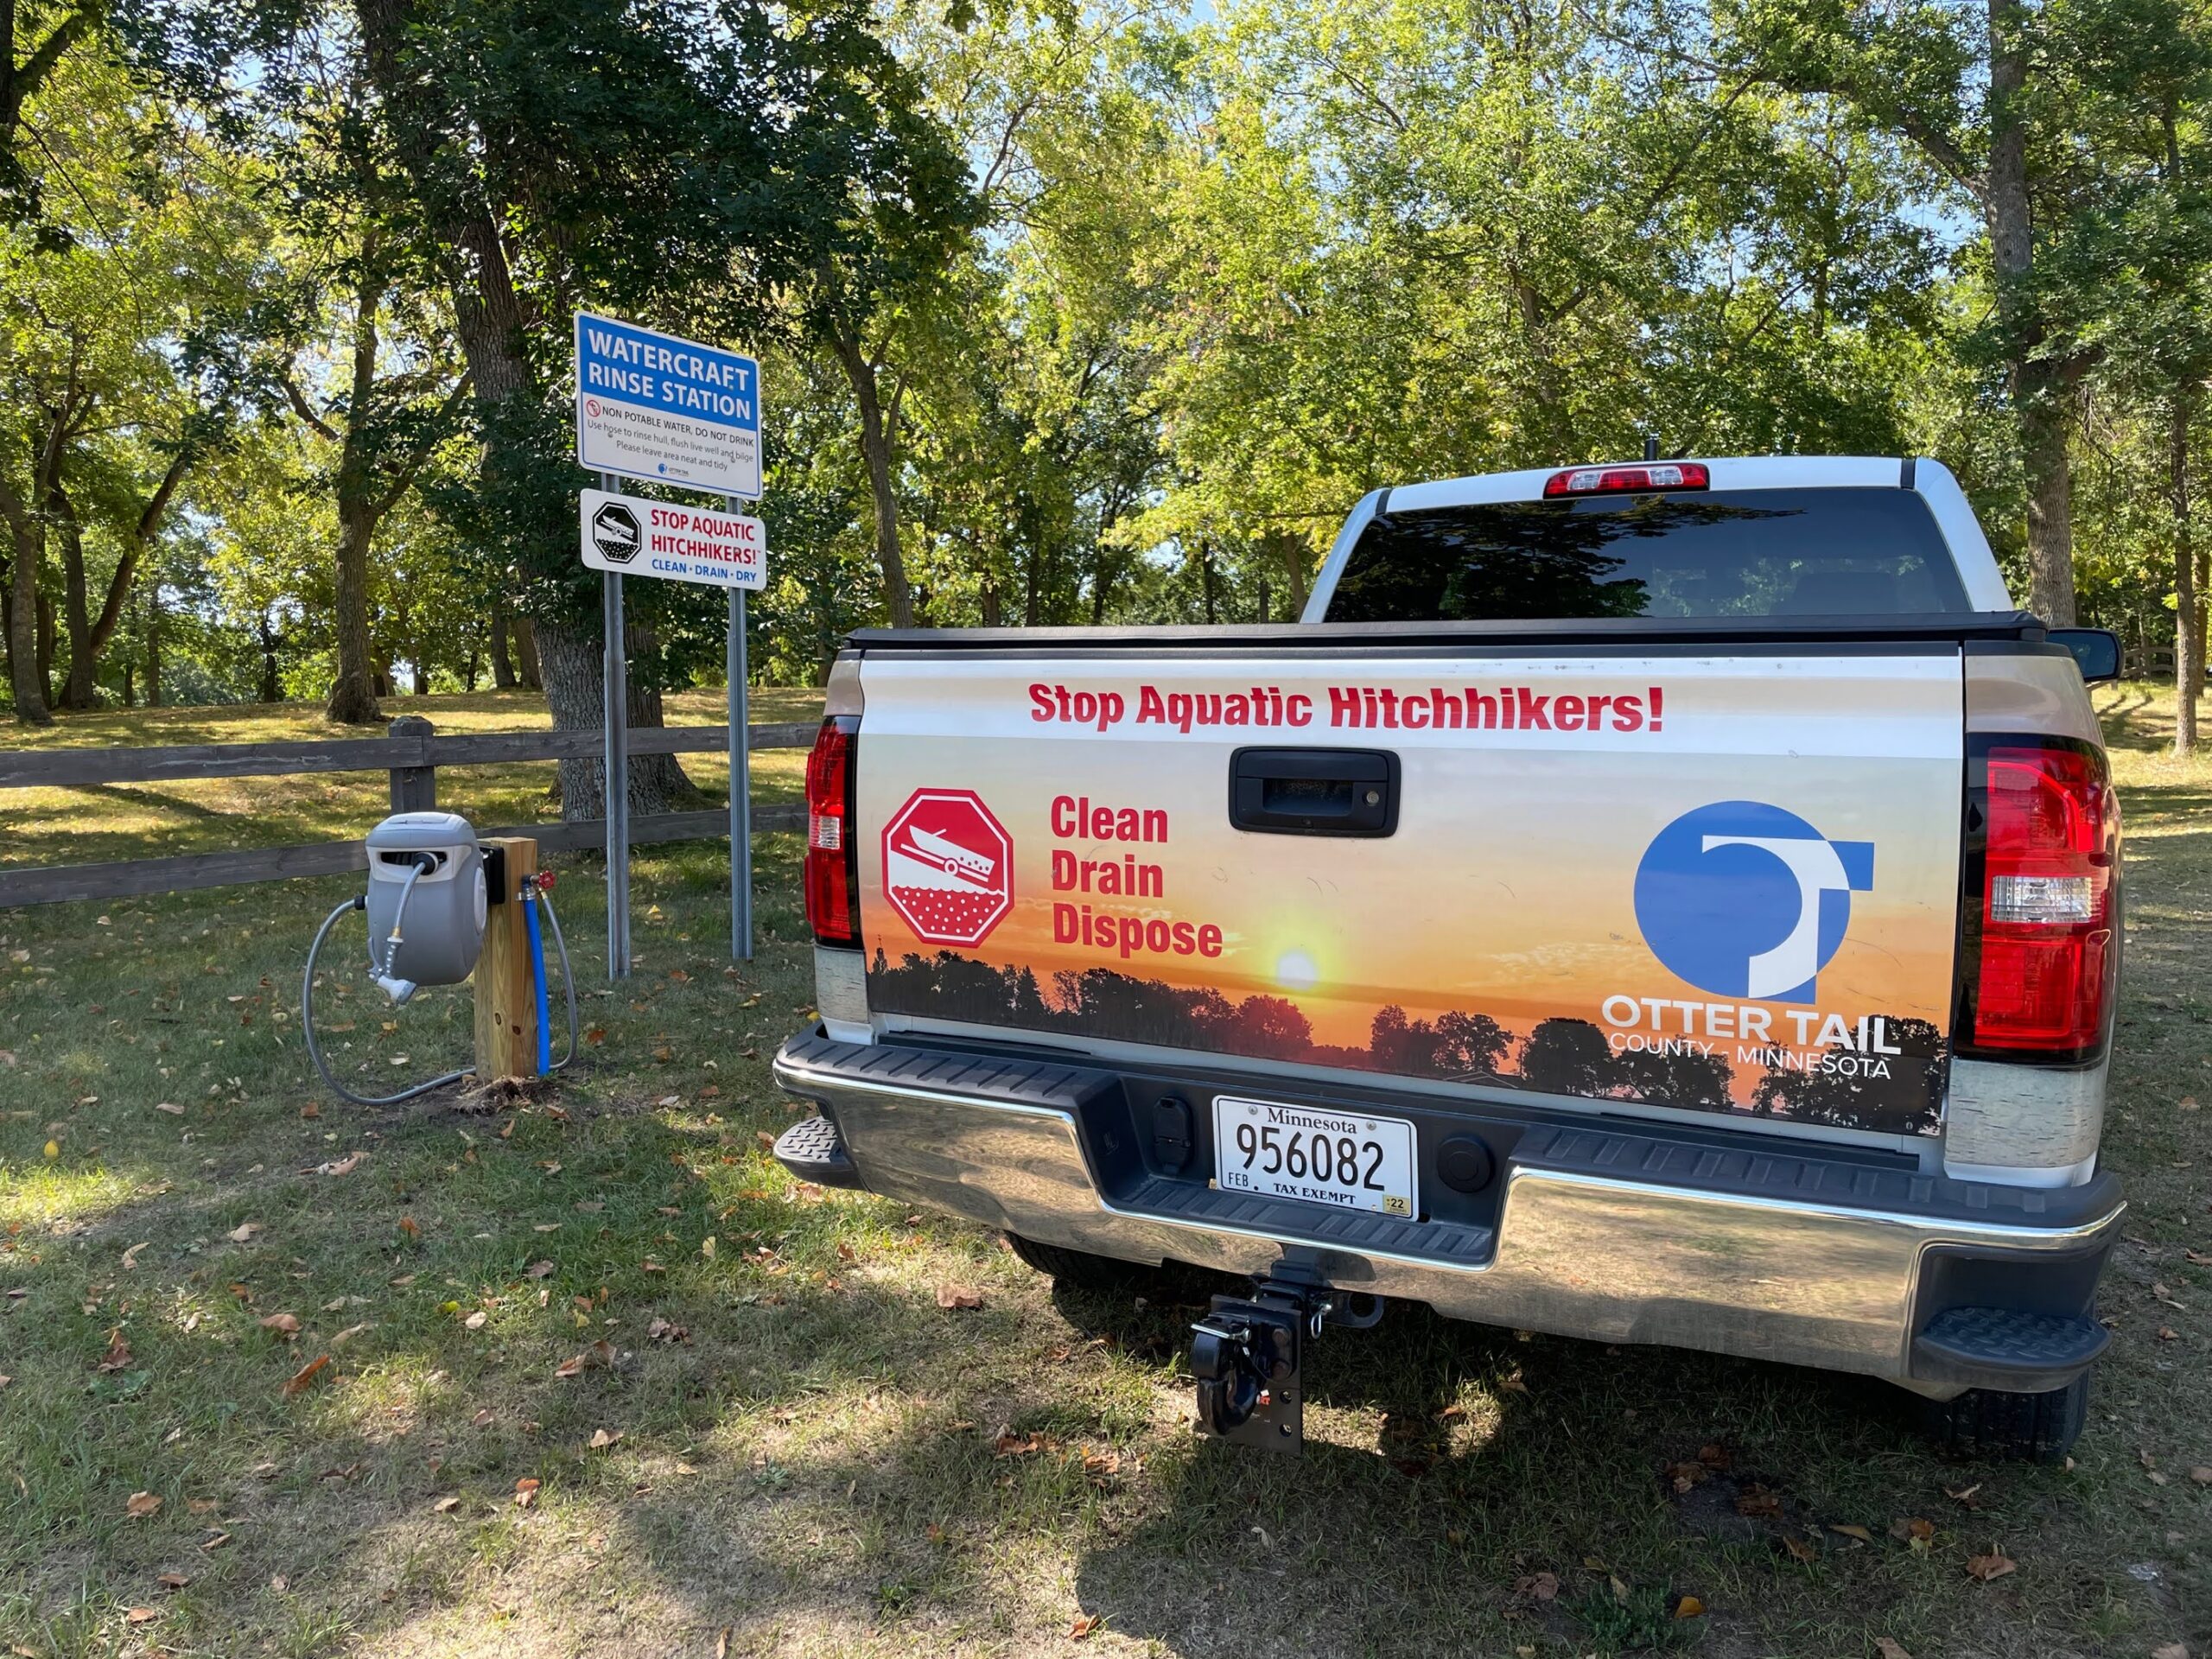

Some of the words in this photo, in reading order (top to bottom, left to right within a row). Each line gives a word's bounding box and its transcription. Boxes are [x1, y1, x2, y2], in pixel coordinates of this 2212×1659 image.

[588, 328, 749, 391] WATERCRAFT
[588, 362, 654, 398] RINSE
[662, 381, 750, 420] STATION
[588, 419, 601, 429] Use
[604, 423, 622, 434] hose
[633, 430, 652, 441] rinse
[671, 437, 689, 448] flush
[690, 442, 702, 452] live
[721, 449, 734, 458] and
[735, 451, 753, 462] bilge
[602, 406, 622, 418] NON
[625, 411, 661, 428] POTABLE
[696, 428, 708, 437] DO
[710, 431, 727, 441] NOT
[729, 435, 754, 448] DRINK
[616, 440, 641, 453] Please
[642, 445, 662, 456] leave
[664, 451, 679, 461] area
[681, 455, 697, 464] neat
[698, 459, 712, 467] and
[715, 461, 728, 471] tidy
[651, 509, 689, 531] STOP
[691, 516, 754, 541] AQUATIC
[652, 534, 756, 565] HITCHHIKERS!
[652, 559, 687, 574] CLEAN
[695, 565, 728, 579] DRAIN
[736, 570, 757, 582] DRY
[1028, 683, 1123, 732] Stop
[1136, 685, 1313, 734] Aquatic
[1328, 687, 1663, 732] Hitchhikers!
[1051, 795, 1167, 843] Clean
[1052, 849, 1163, 898] Drain
[1053, 902, 1223, 958] Dispose
[1601, 995, 1771, 1042] OTTER
[1786, 1010, 1902, 1055] TAIL
[1610, 1033, 1714, 1060] COUNTY
[1737, 1046, 1891, 1080] MINNESOTA
[1268, 1108, 1357, 1135] Minnesota
[1236, 1123, 1385, 1192] 956082
[1228, 1172, 1249, 1187] FEB
[1273, 1183, 1297, 1196] TAX
[1302, 1186, 1356, 1205] EXEMPT
[1391, 1198, 1404, 1209] 22
